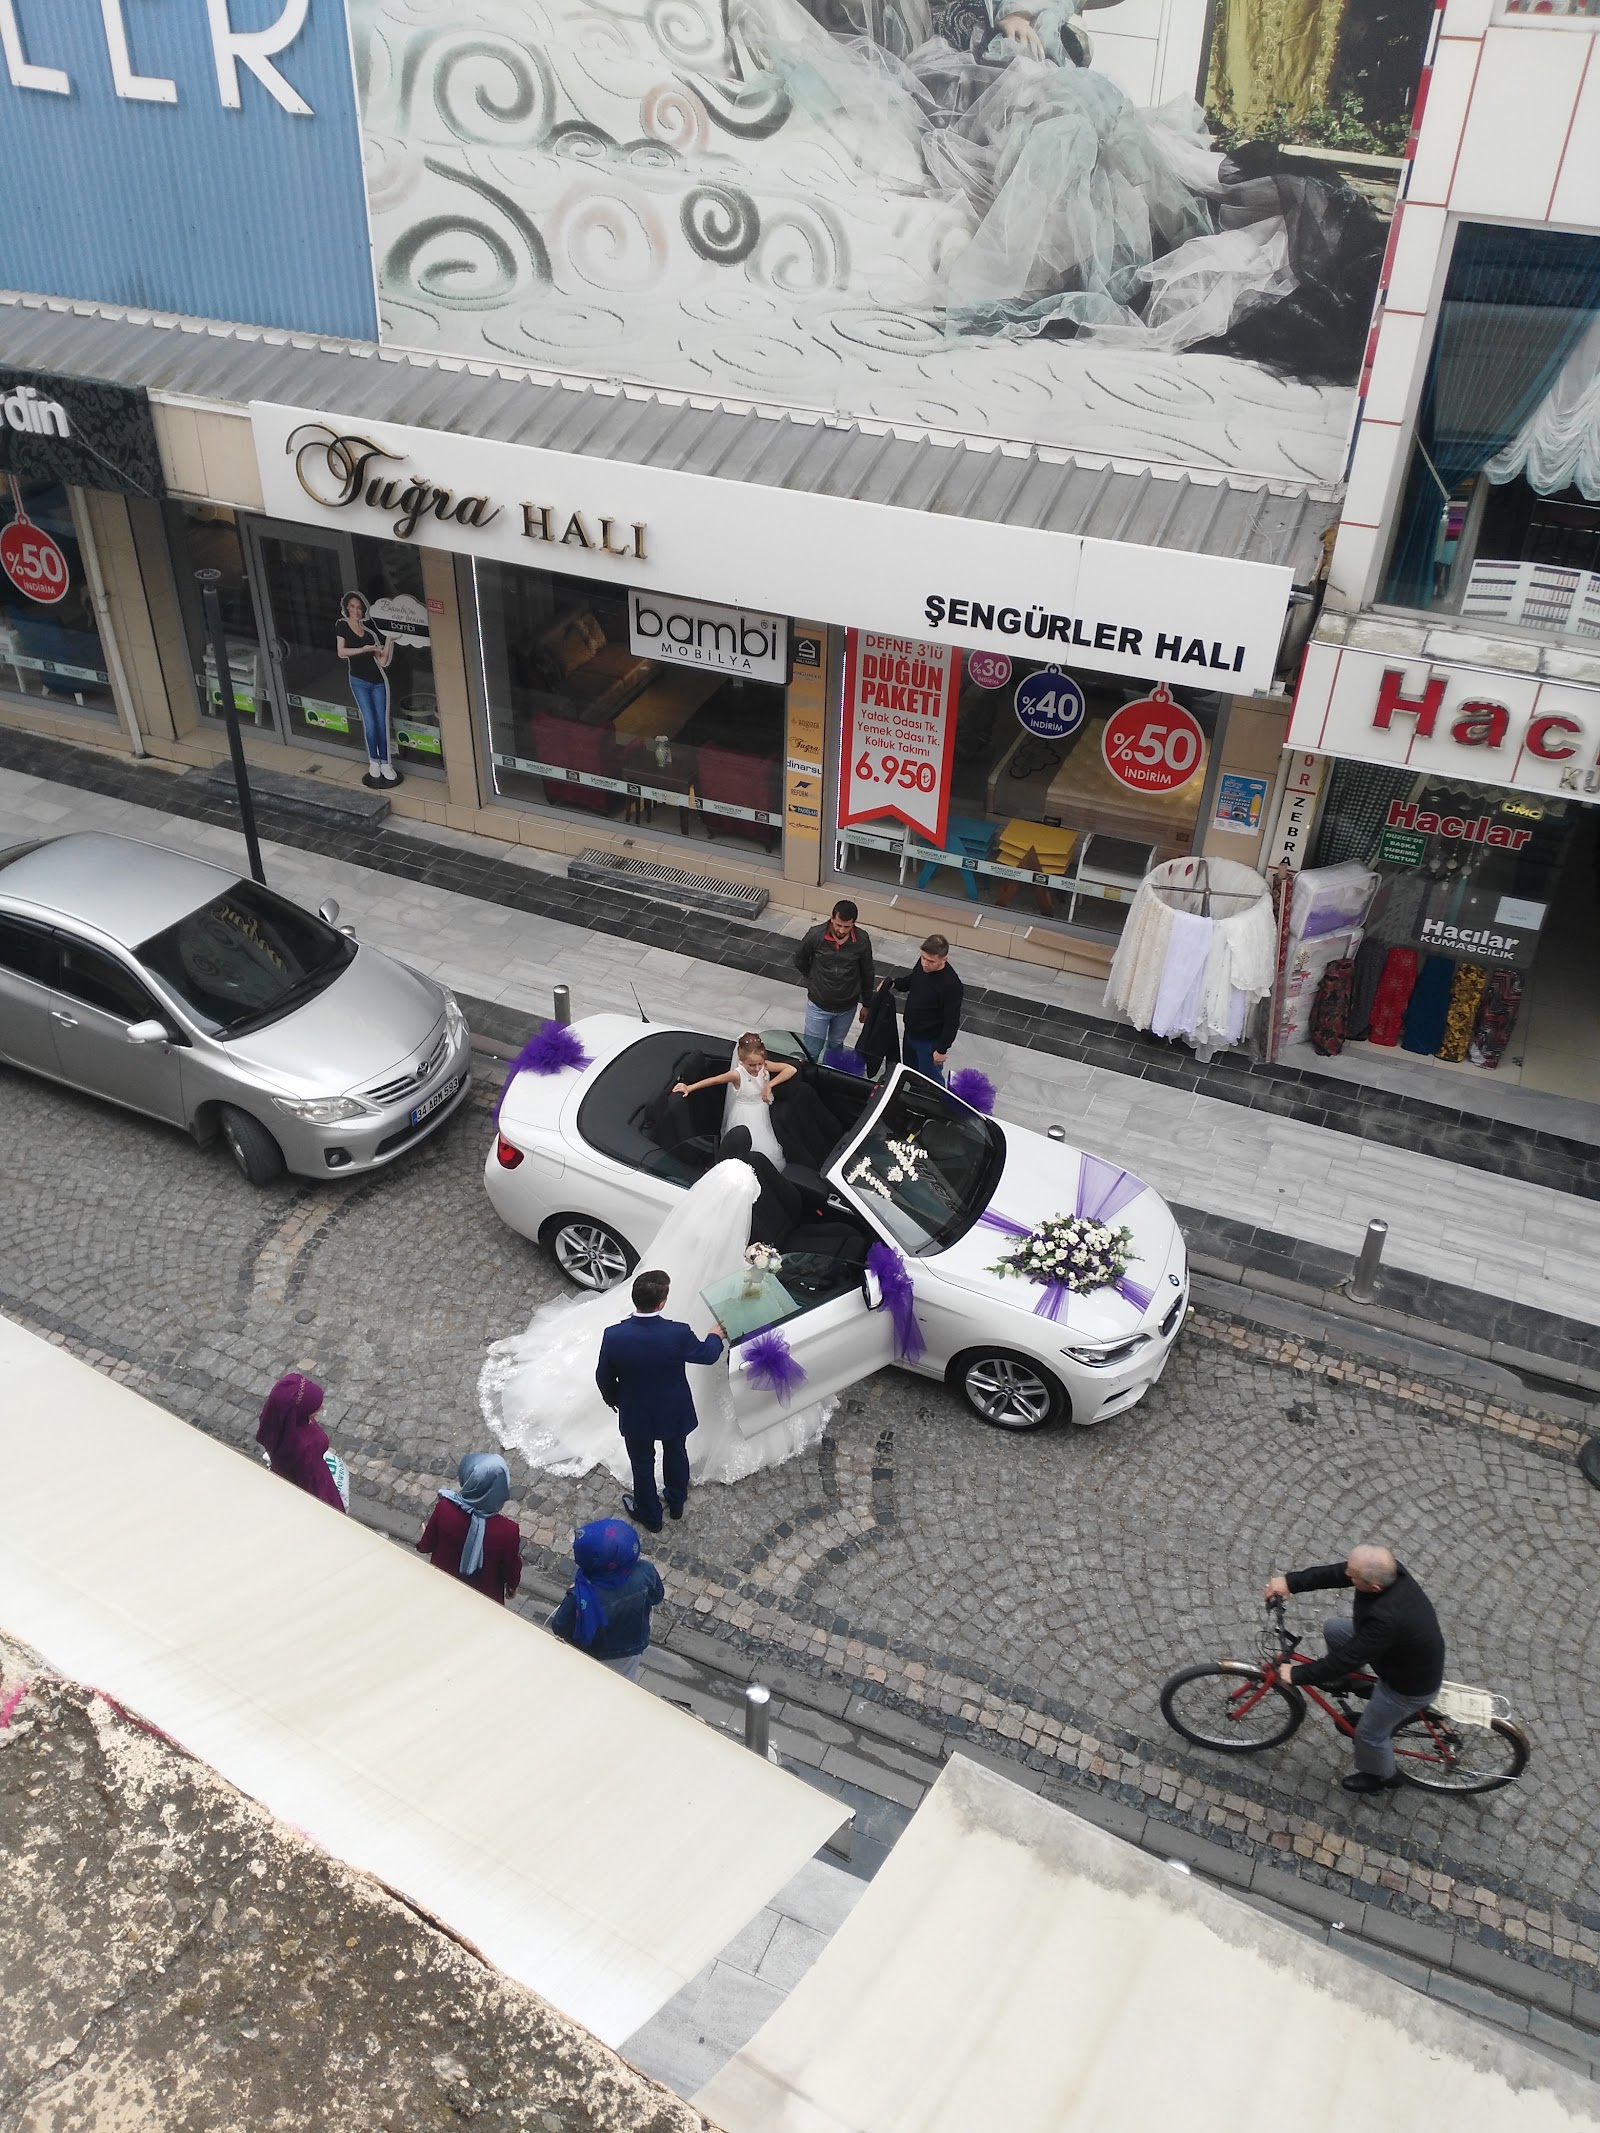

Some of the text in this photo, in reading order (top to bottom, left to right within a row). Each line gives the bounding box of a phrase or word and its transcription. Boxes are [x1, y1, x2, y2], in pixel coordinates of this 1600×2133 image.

[285, 421, 648, 560] Tuğra HALI
[6, 543, 63, 583] %50
[23, 581, 57, 595] İNDİRİM
[391, 621, 416, 632] bambi
[636, 598, 777, 660] bambi
[924, 594, 1246, 673] ŞENGÜRLER HALI
[661, 643, 751, 669] MOBİLYA
[866, 634, 913, 654] DEFNE
[862, 652, 944, 692] DÜĞÜN
[973, 659, 1008, 679] %30
[977, 676, 1000, 685] İNDİRİM
[1021, 690, 1079, 722] %40
[1370, 665, 1600, 765] Hac
[798, 719, 820, 729] angora
[857, 721, 940, 746] Yemek Odası Tk.
[861, 708, 938, 733] Yatak Odası Tk.
[1030, 718, 1063, 732] İNDİRİM
[865, 735, 930, 757] Koltuk Takımı
[1111, 723, 1197, 770] %50
[855, 750, 936, 793] 6.950
[1124, 766, 1172, 785] İNDİRİM
[1280, 797, 1306, 867] ZEBRA
[1386, 799, 1533, 850] Hacılar
[1384, 853, 1417, 863] YOKTUR
[1390, 840, 1416, 850] BAŞKA
[1422, 918, 1520, 951] Hacılar
[417, 1104, 427, 1119] 34
[444, 1078, 458, 1096] 593
